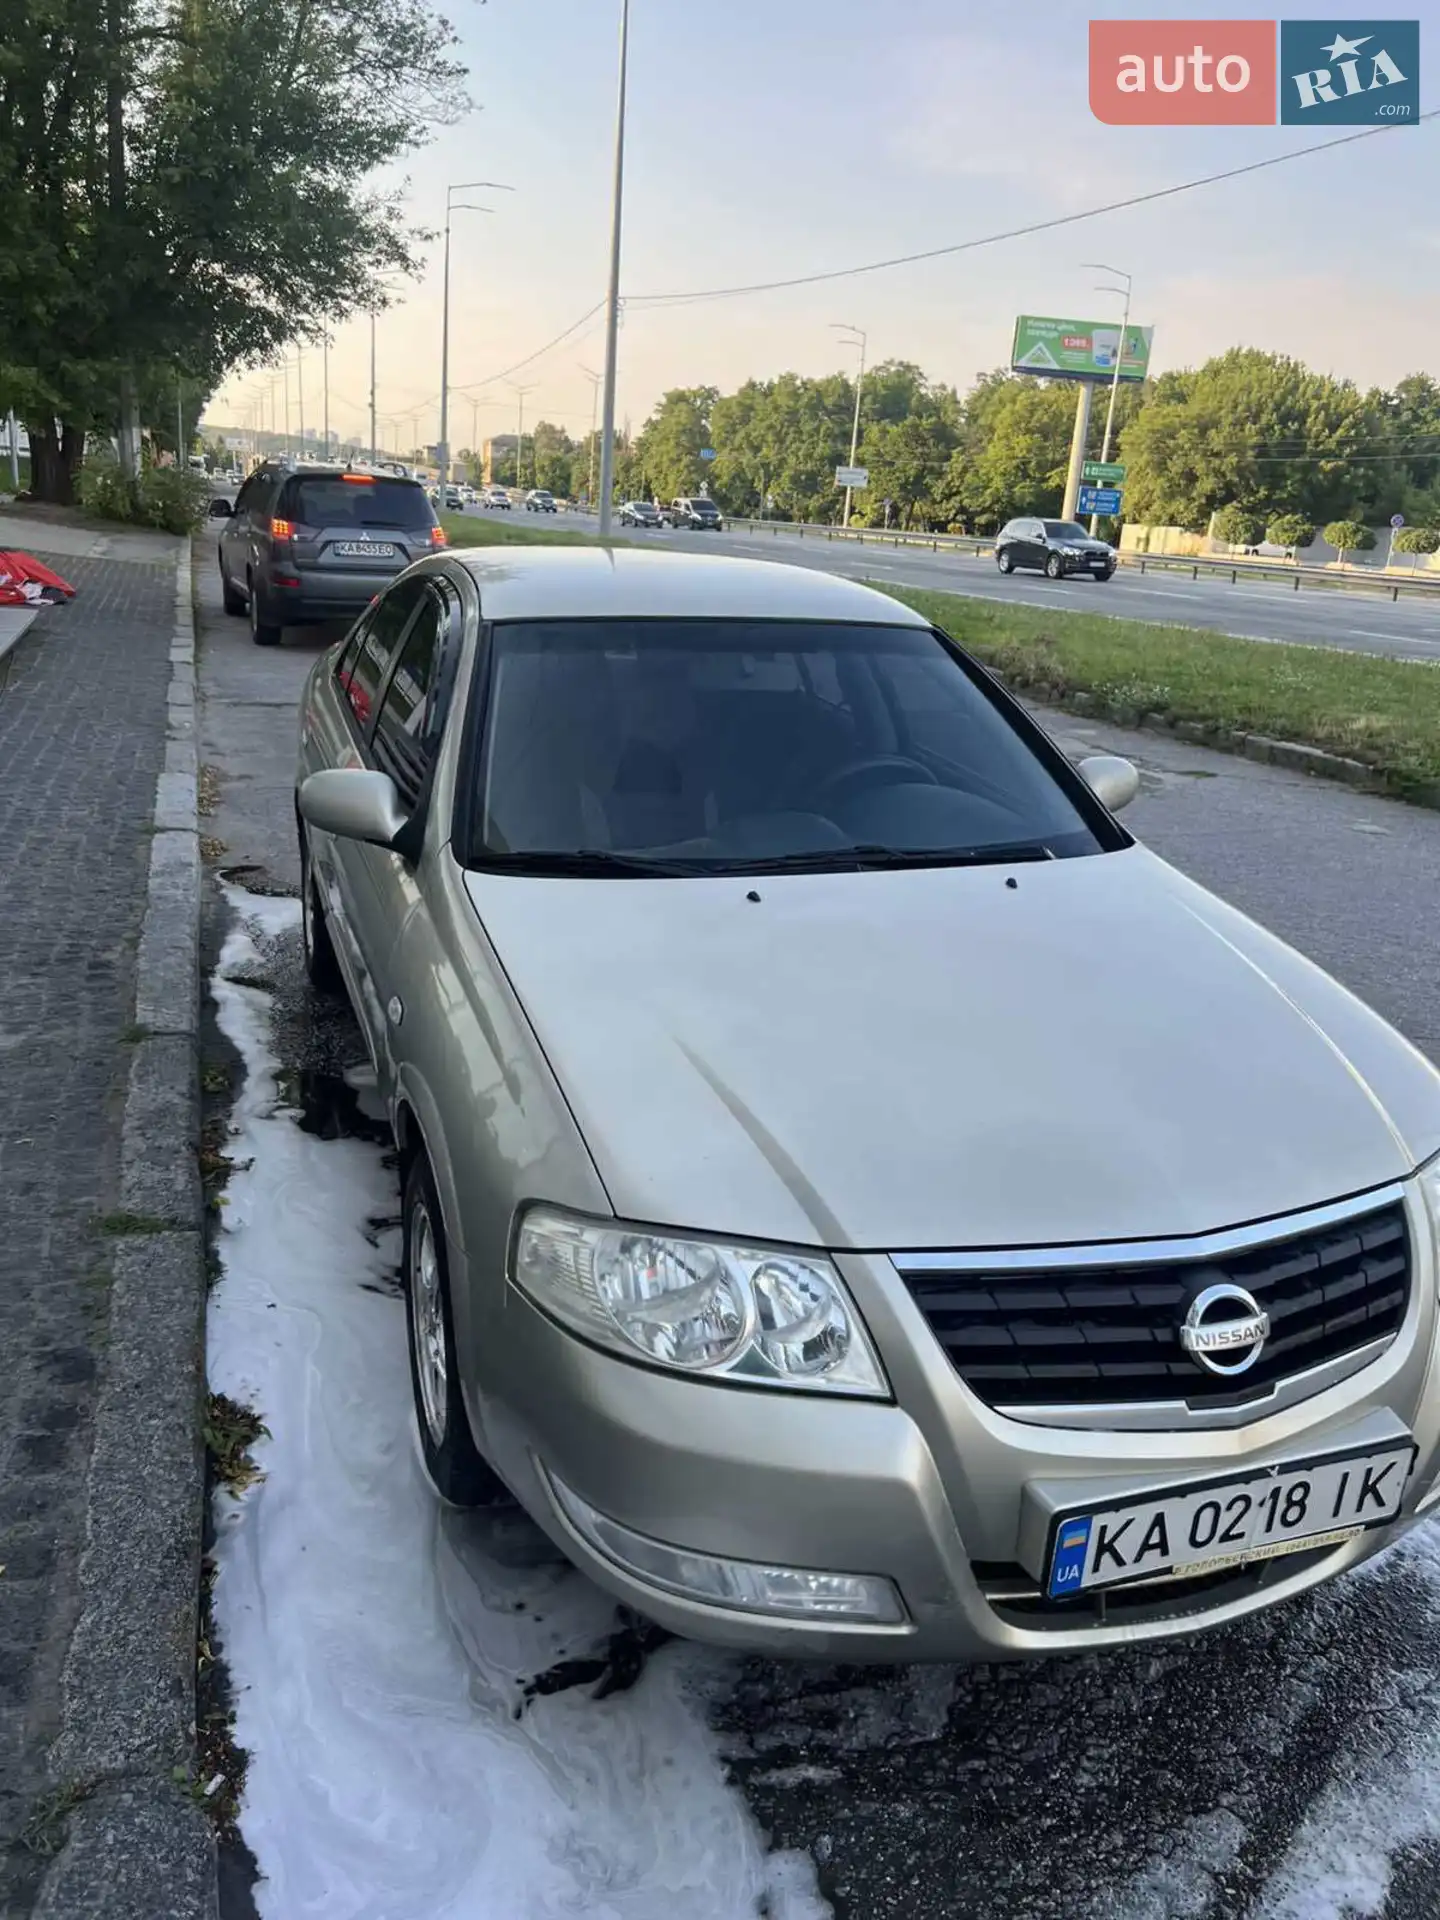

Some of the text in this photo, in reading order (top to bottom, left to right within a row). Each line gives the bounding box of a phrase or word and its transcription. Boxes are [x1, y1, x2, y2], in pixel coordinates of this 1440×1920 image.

[1194, 1321, 1266, 1347] NISSAN
[1091, 1460, 1398, 1575] KA 0218 IK
[1056, 1566, 1081, 1583] UA
